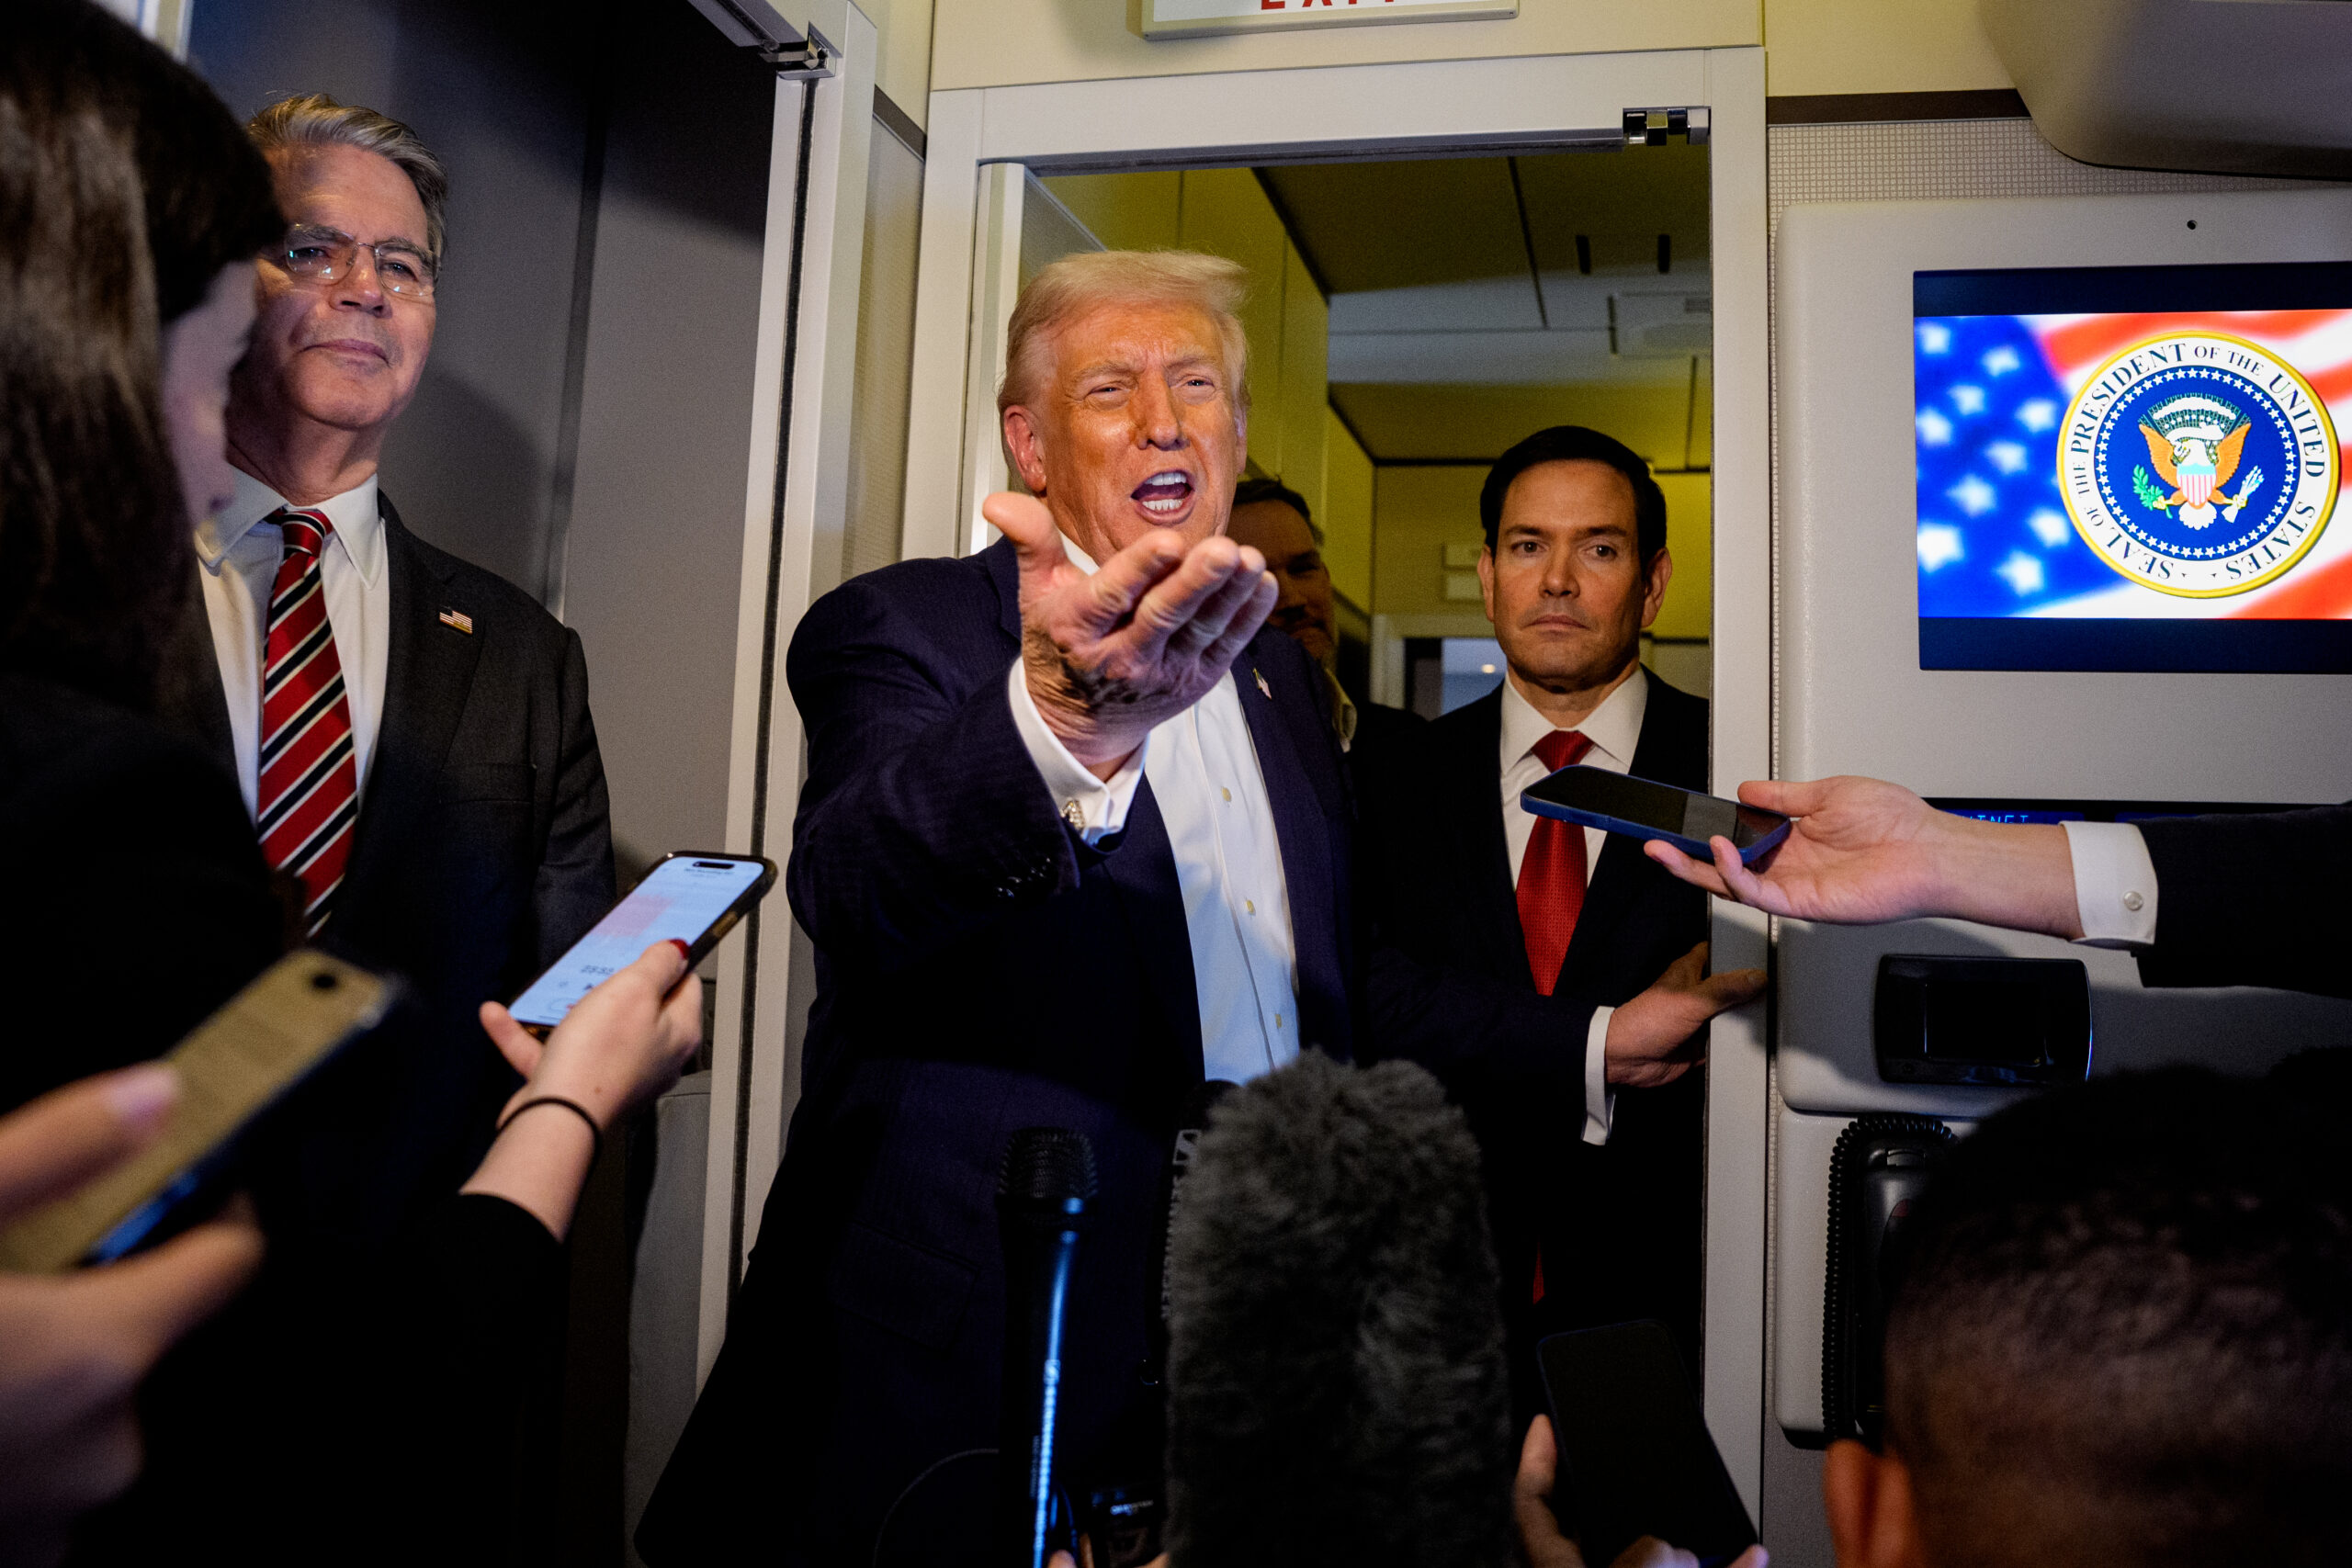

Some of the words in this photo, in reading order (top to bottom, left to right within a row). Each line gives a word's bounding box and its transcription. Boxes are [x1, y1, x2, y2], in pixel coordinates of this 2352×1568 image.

[2194, 345, 2220, 359] OF
[2227, 350, 2264, 377] THE
[2071, 343, 2186, 454] PRESIDENT
[2268, 373, 2325, 478] UNITED
[2073, 461, 2090, 498] THE
[2084, 507, 2104, 526] OF
[2107, 526, 2174, 580] SEAL
[2225, 501, 2315, 580] STATES
